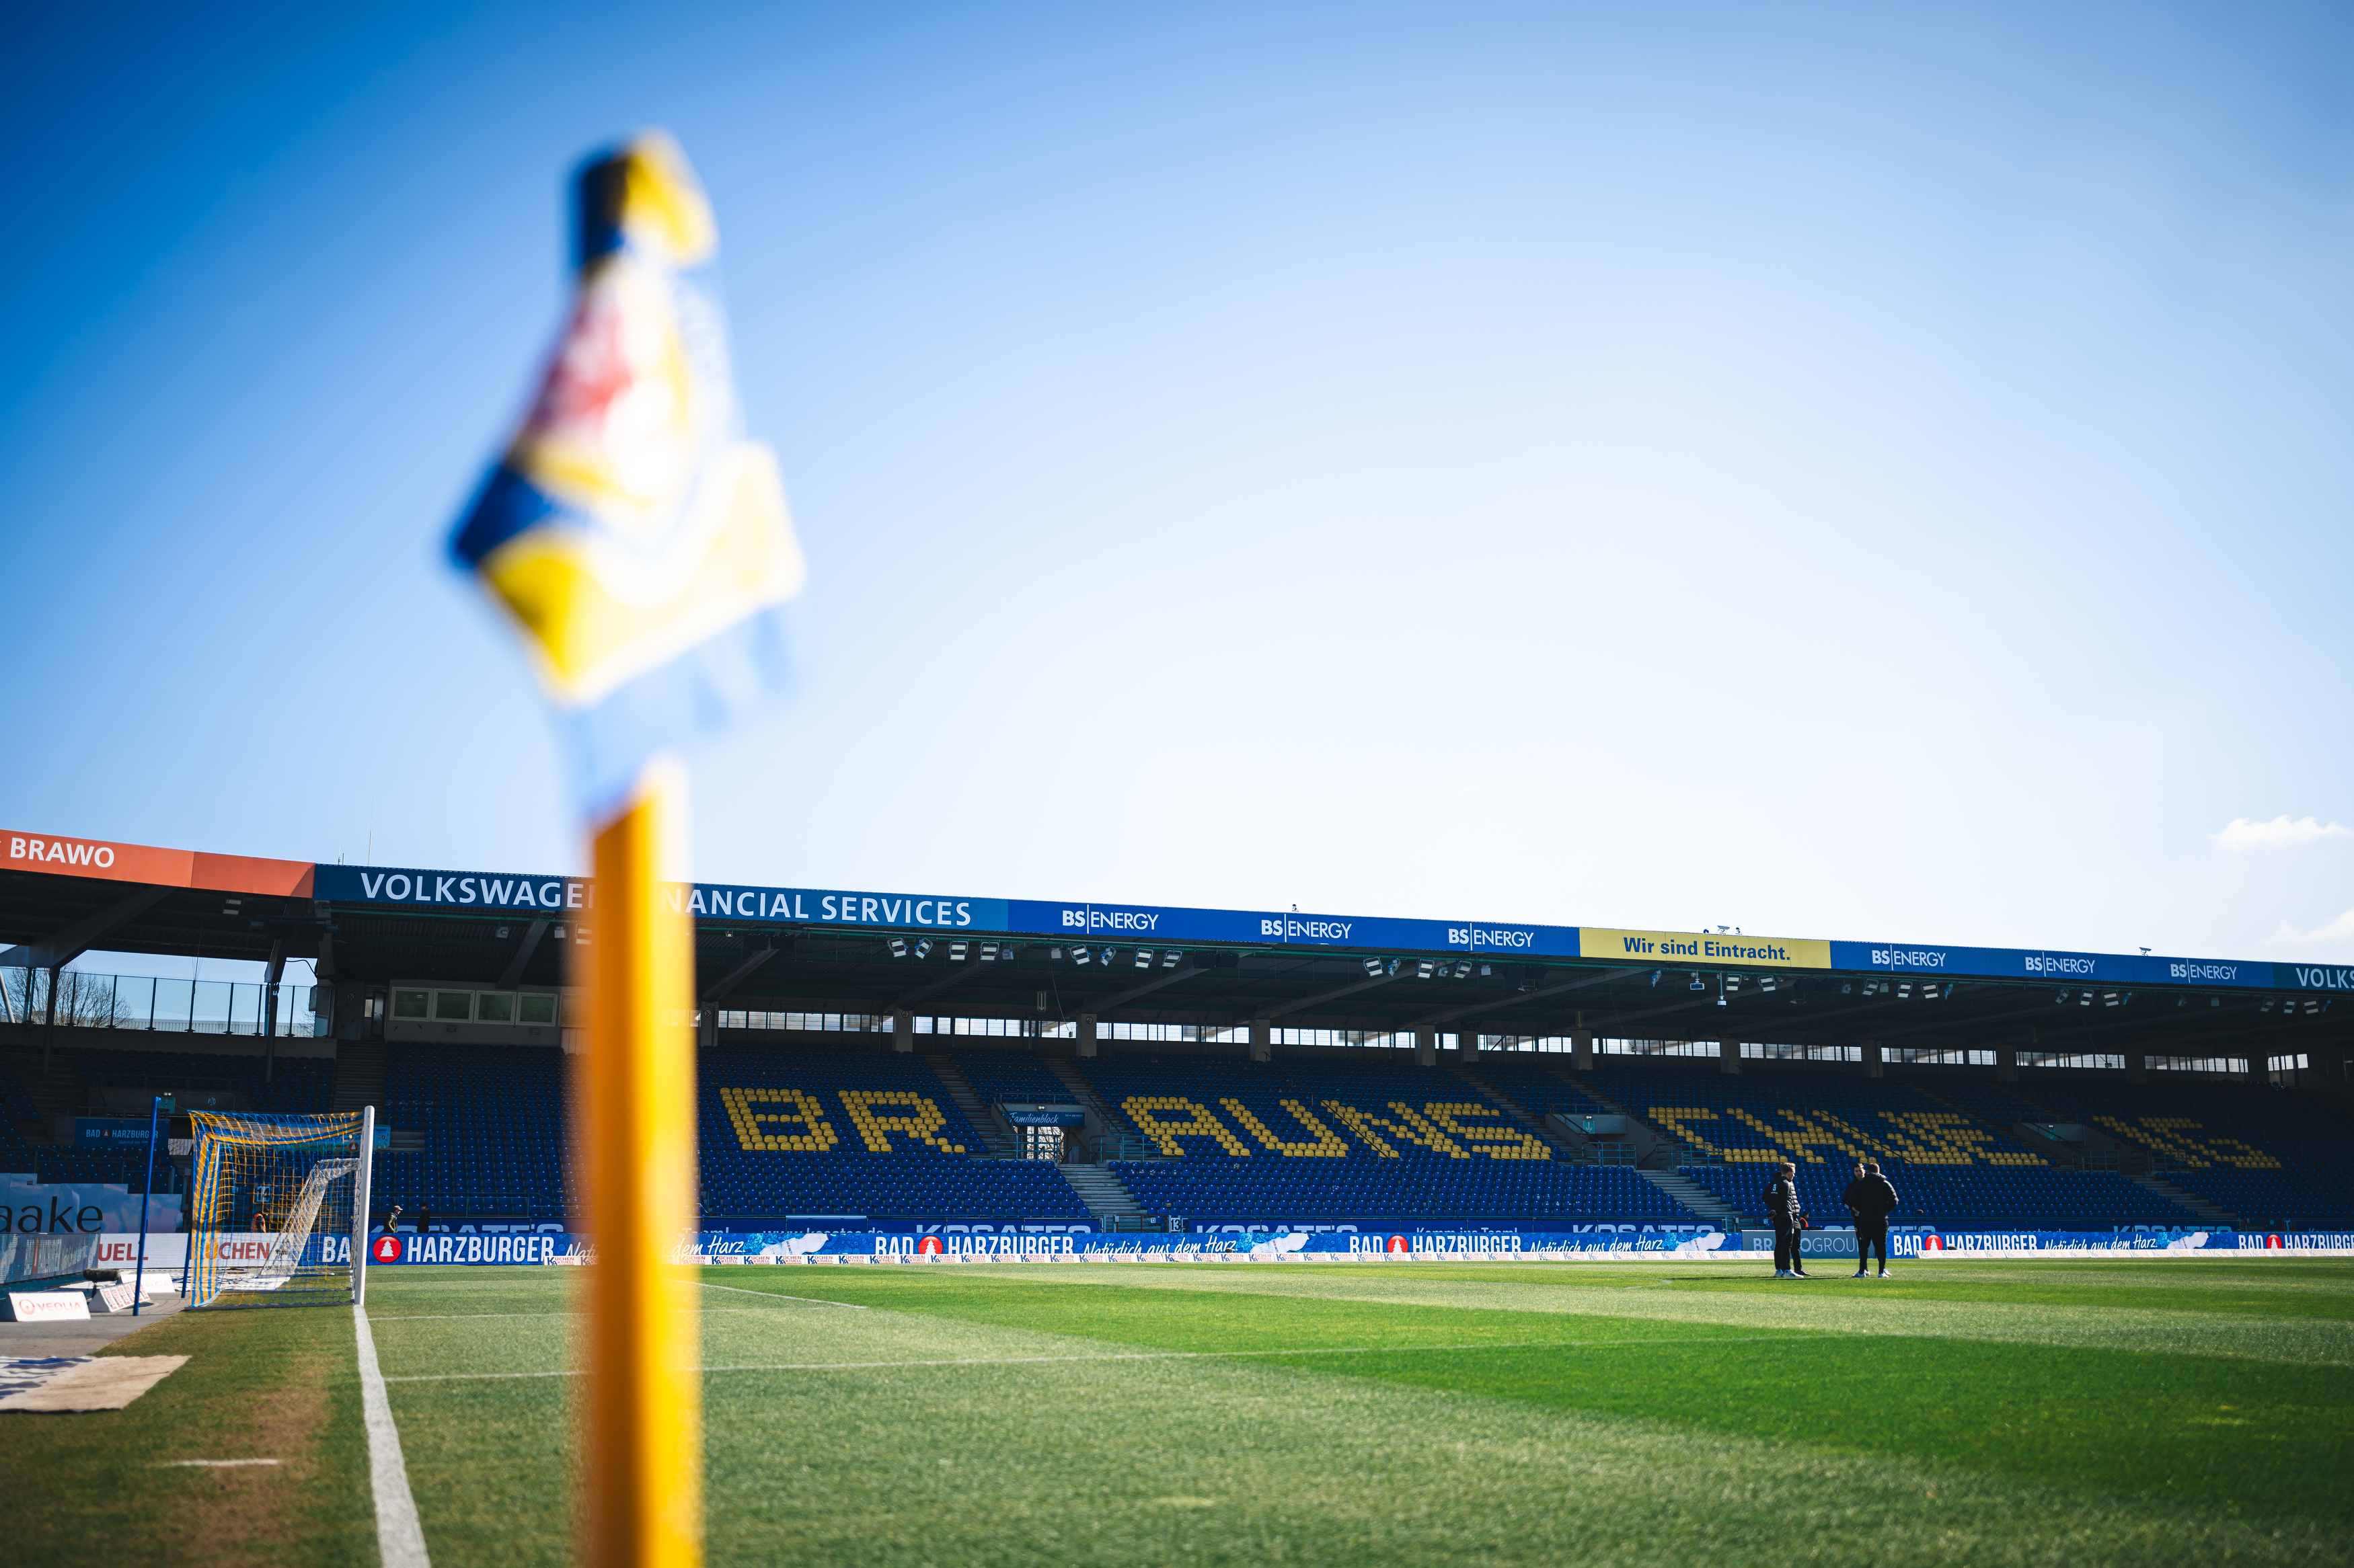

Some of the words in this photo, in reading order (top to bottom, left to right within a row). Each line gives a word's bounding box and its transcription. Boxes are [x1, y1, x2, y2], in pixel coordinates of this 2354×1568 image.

[10, 837, 115, 867] BRAWO
[360, 873, 598, 908] VOLKSWAGE
[822, 896, 971, 926] SERVICES
[1623, 937, 1655, 953] Wir
[1661, 939, 1698, 955] sind
[1704, 941, 1790, 960] Eintracht.
[1010, 1112, 1059, 1124] Familienblock
[86, 1130, 100, 1138] BAD
[112, 1130, 158, 1138] HARZBURGR
[257, 1186, 270, 1201] 14
[1171, 1219, 1180, 1230] 13
[322, 1237, 352, 1263] BA
[407, 1236, 554, 1262] HARZBURGER
[708, 1235, 746, 1255] Harz.
[948, 1236, 1073, 1254] HARZBURGER
[1174, 1237, 1201, 1253] dem
[1205, 1234, 1238, 1253] Harz.
[1412, 1235, 1521, 1252] HARZBURGER
[1609, 1237, 1632, 1251] dem
[1636, 1234, 1665, 1251] Harz.
[1893, 1235, 1922, 1256] BAD
[2111, 1235, 2131, 1250] dem
[2133, 1234, 2158, 1249] Harz.
[36, 1301, 82, 1312] VEOLIA
